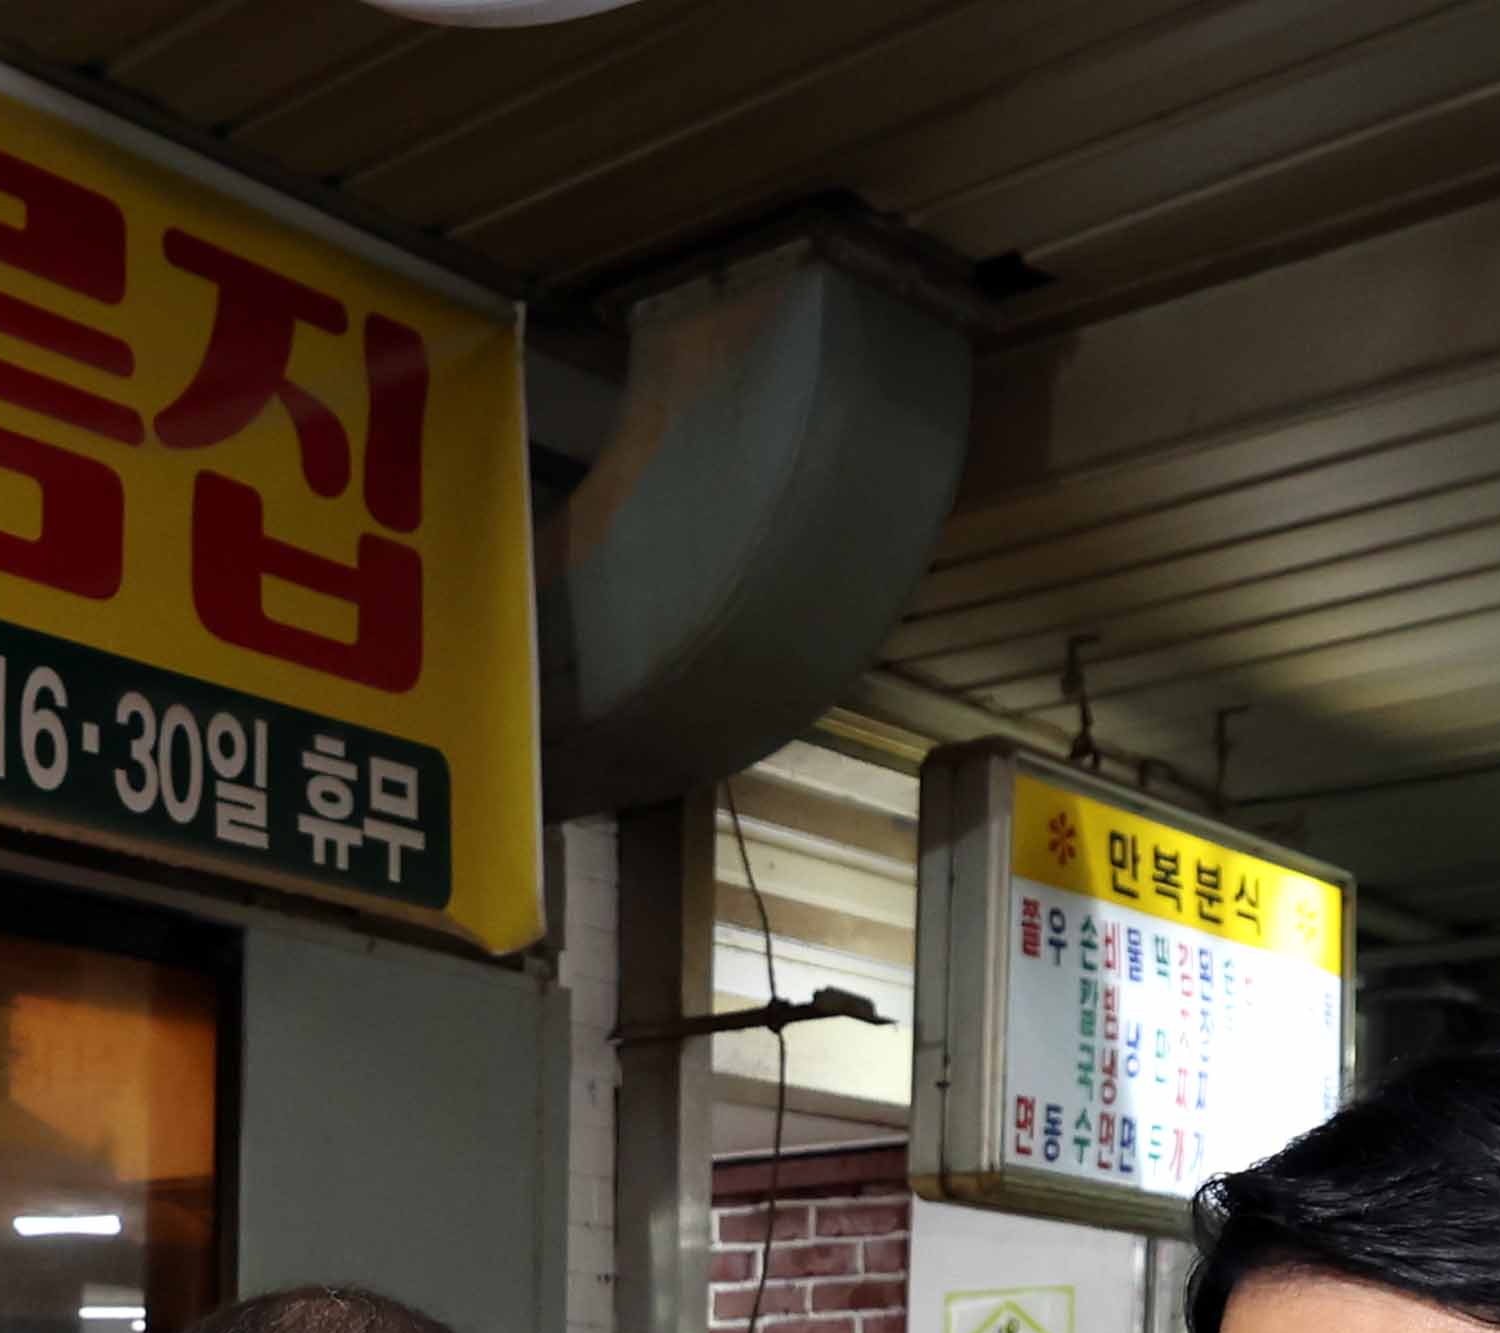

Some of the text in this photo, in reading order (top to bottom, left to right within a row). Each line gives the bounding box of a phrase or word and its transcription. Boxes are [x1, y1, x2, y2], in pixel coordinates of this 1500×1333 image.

[297, 732, 425, 885] 휴무
[1106, 828, 1262, 936] 만복분식
[1043, 906, 1068, 1162] 우동
